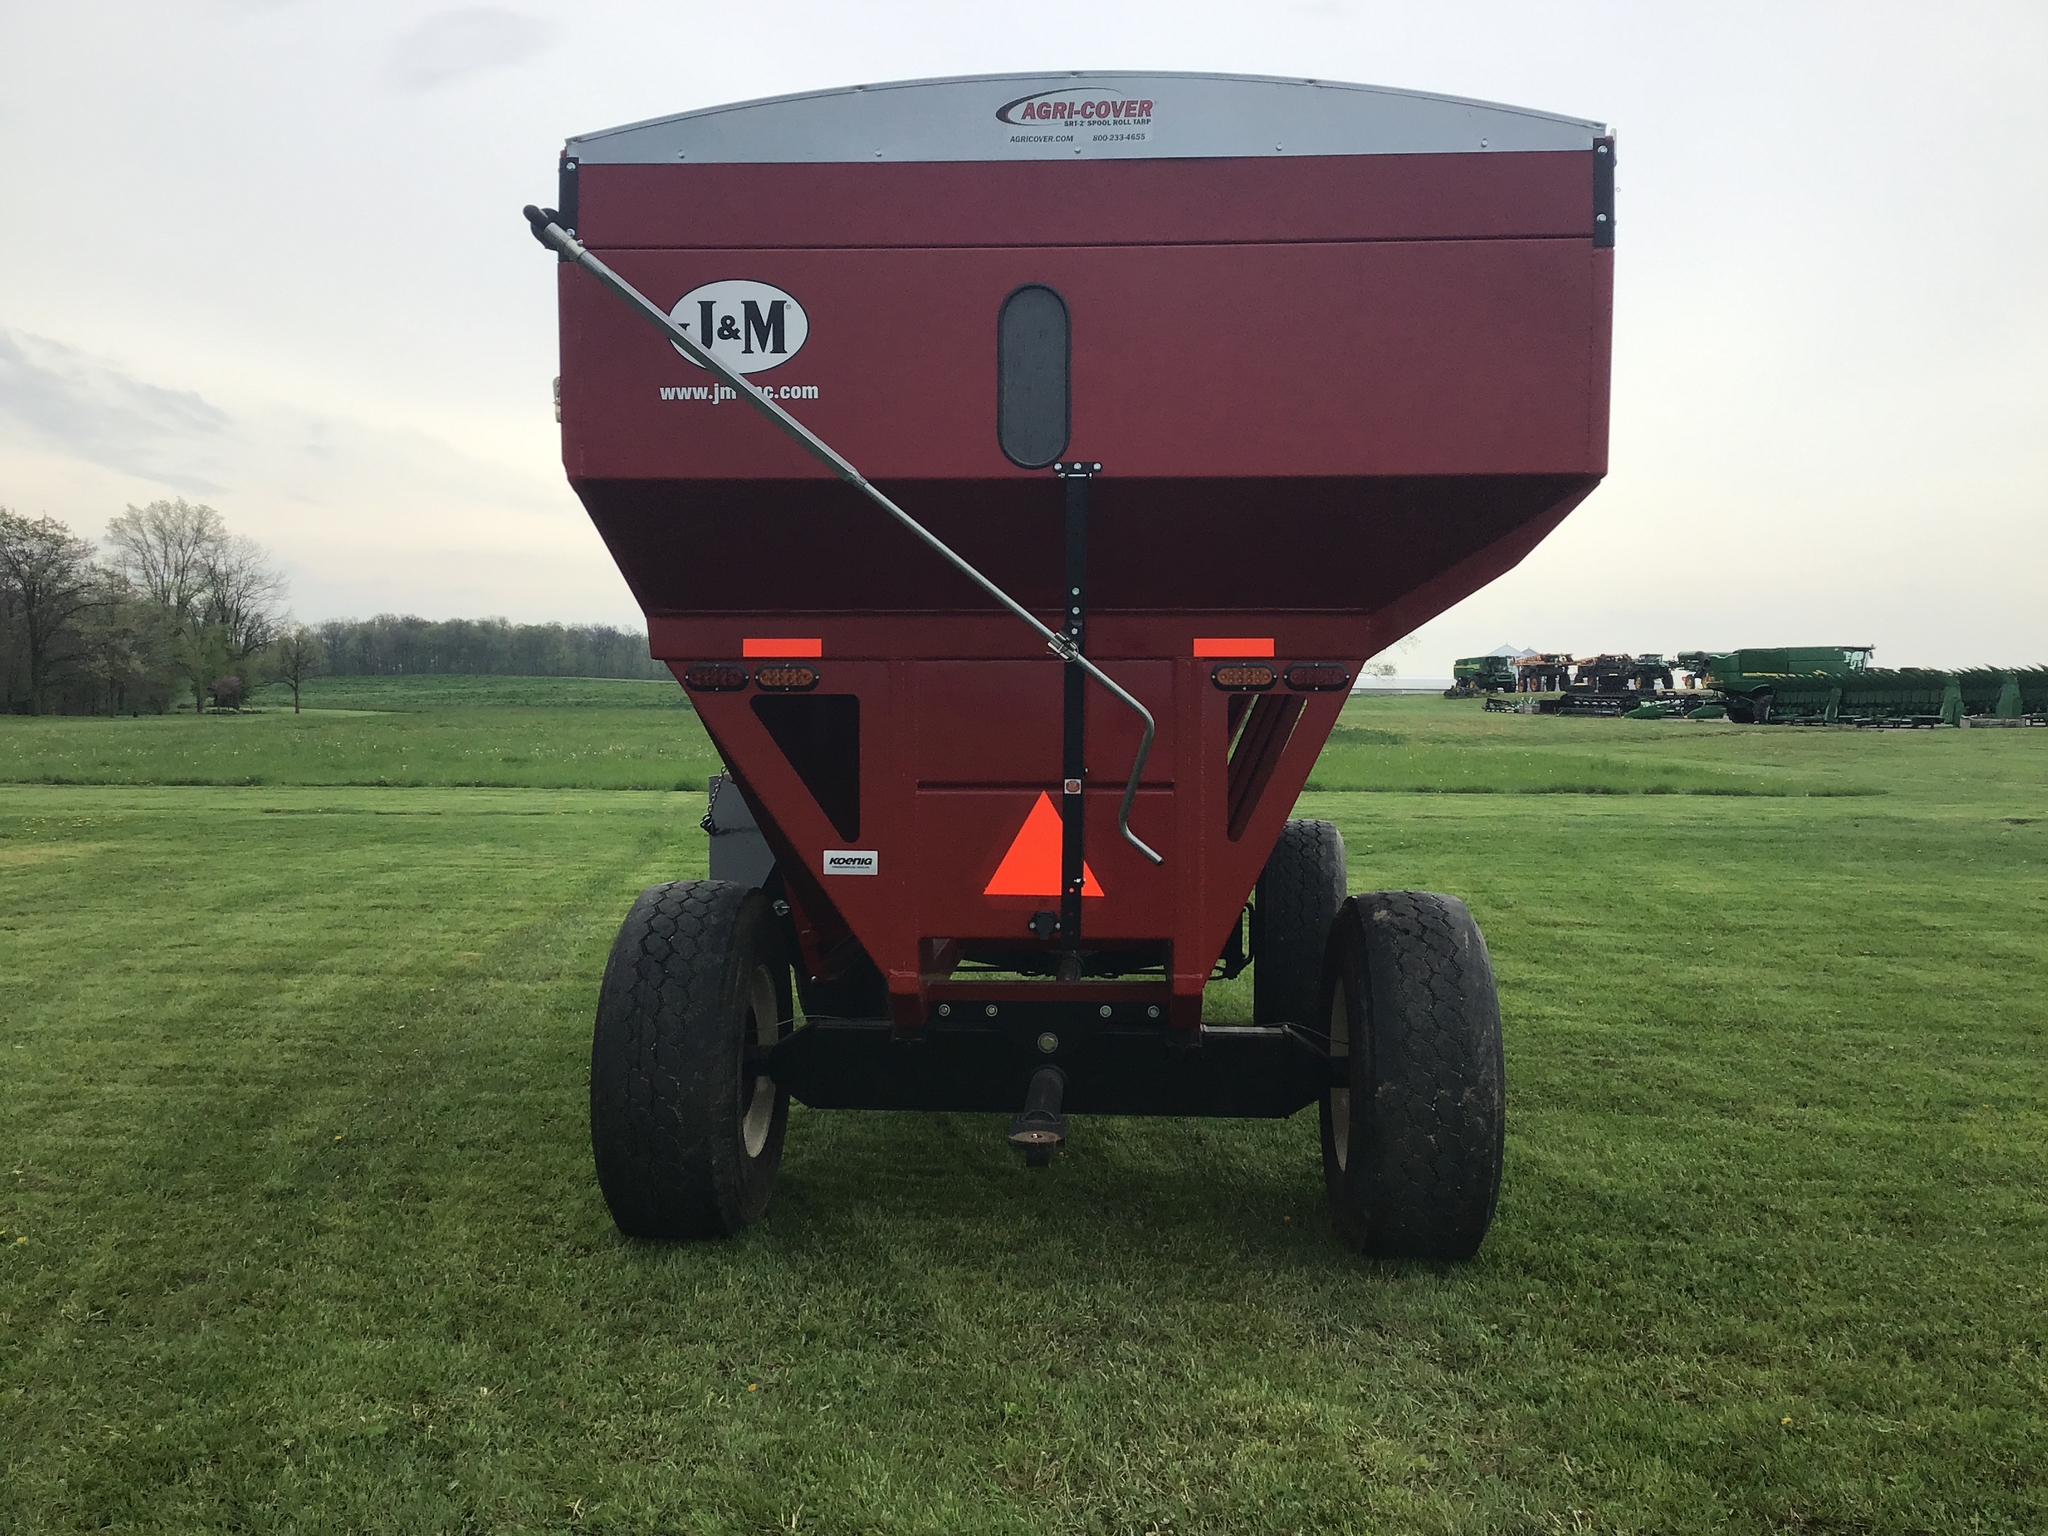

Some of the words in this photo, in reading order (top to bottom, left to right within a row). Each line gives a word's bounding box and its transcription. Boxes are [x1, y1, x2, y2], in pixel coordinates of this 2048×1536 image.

[1021, 100, 1154, 120] AGRI-COVER
[1087, 119, 1111, 127] SPOOL
[1010, 135, 1074, 143] AGRICOVER.COM
[1092, 133, 1146, 142] 800-233-4655
[678, 300, 788, 354] J&M
